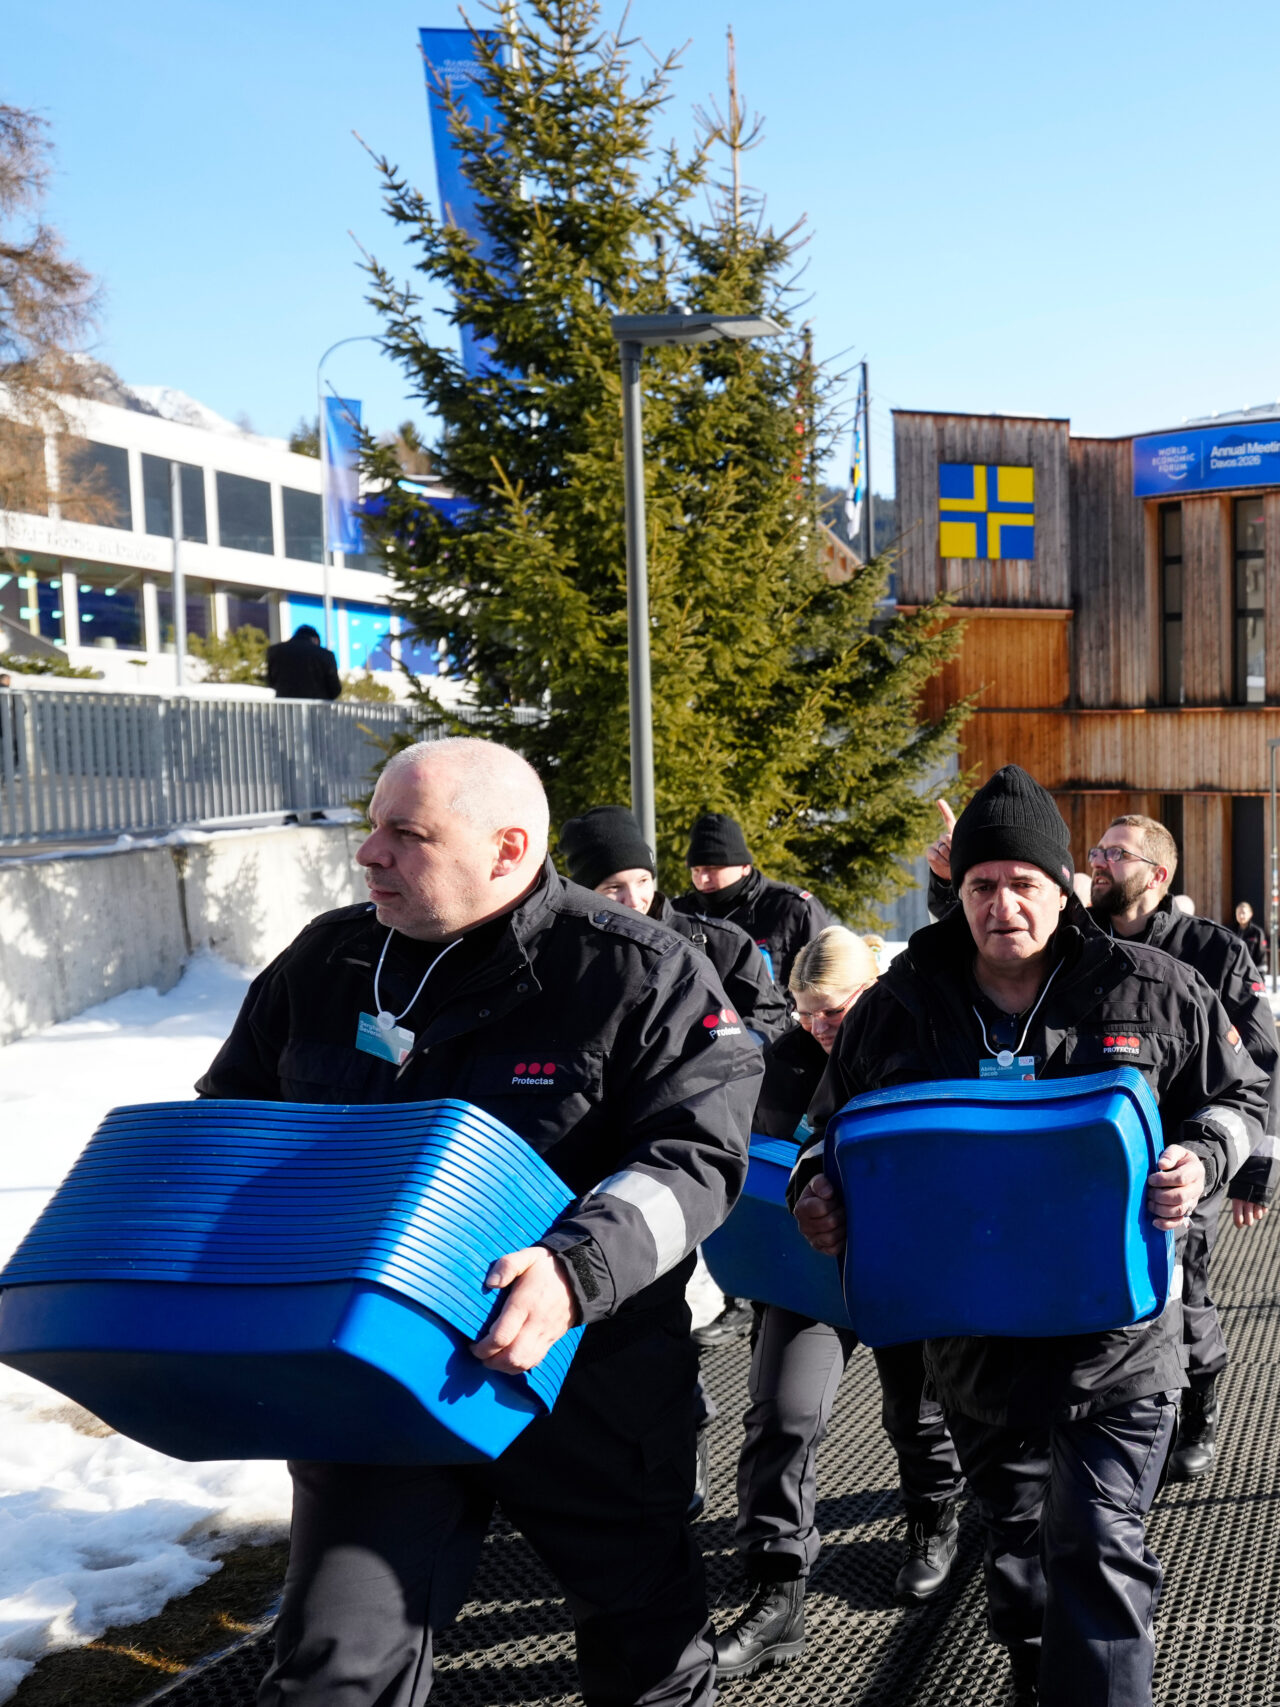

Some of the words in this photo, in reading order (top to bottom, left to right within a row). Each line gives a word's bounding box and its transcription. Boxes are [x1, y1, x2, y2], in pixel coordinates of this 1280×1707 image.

[1158, 446, 1188, 456] WORLD
[1210, 443, 1246, 457] Annual
[1152, 453, 1195, 466] ECONOMIC
[1210, 458, 1236, 469] Davos
[1158, 463, 1188, 473] FORUM
[1103, 1046, 1140, 1054] PROTECTAS
[511, 1076, 554, 1085] Protectas
